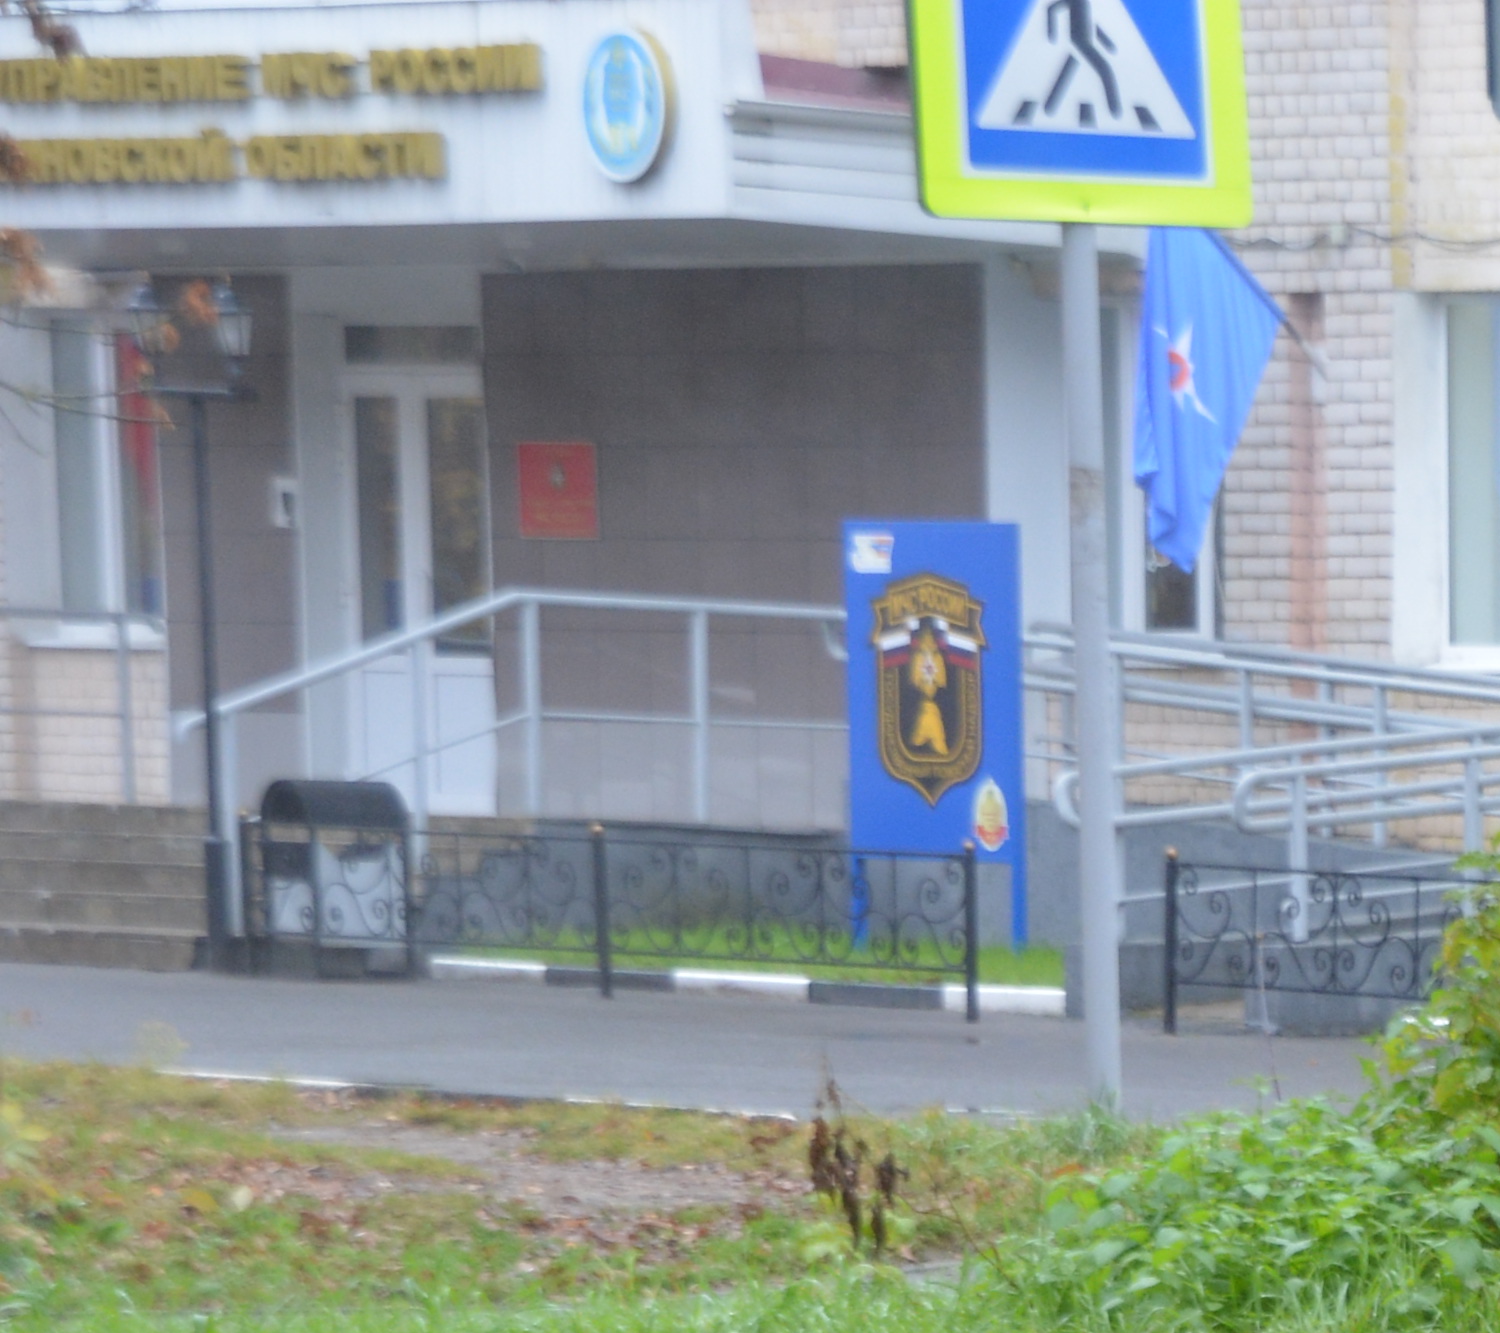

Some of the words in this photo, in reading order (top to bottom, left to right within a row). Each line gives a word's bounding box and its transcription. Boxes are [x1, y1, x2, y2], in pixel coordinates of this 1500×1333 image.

[0, 56, 248, 102] ПРАВЛЕНИЕ
[261, 51, 353, 98] МЧС
[370, 44, 542, 94] РОССИИ
[245, 131, 445, 181] ОБЛАСТИ
